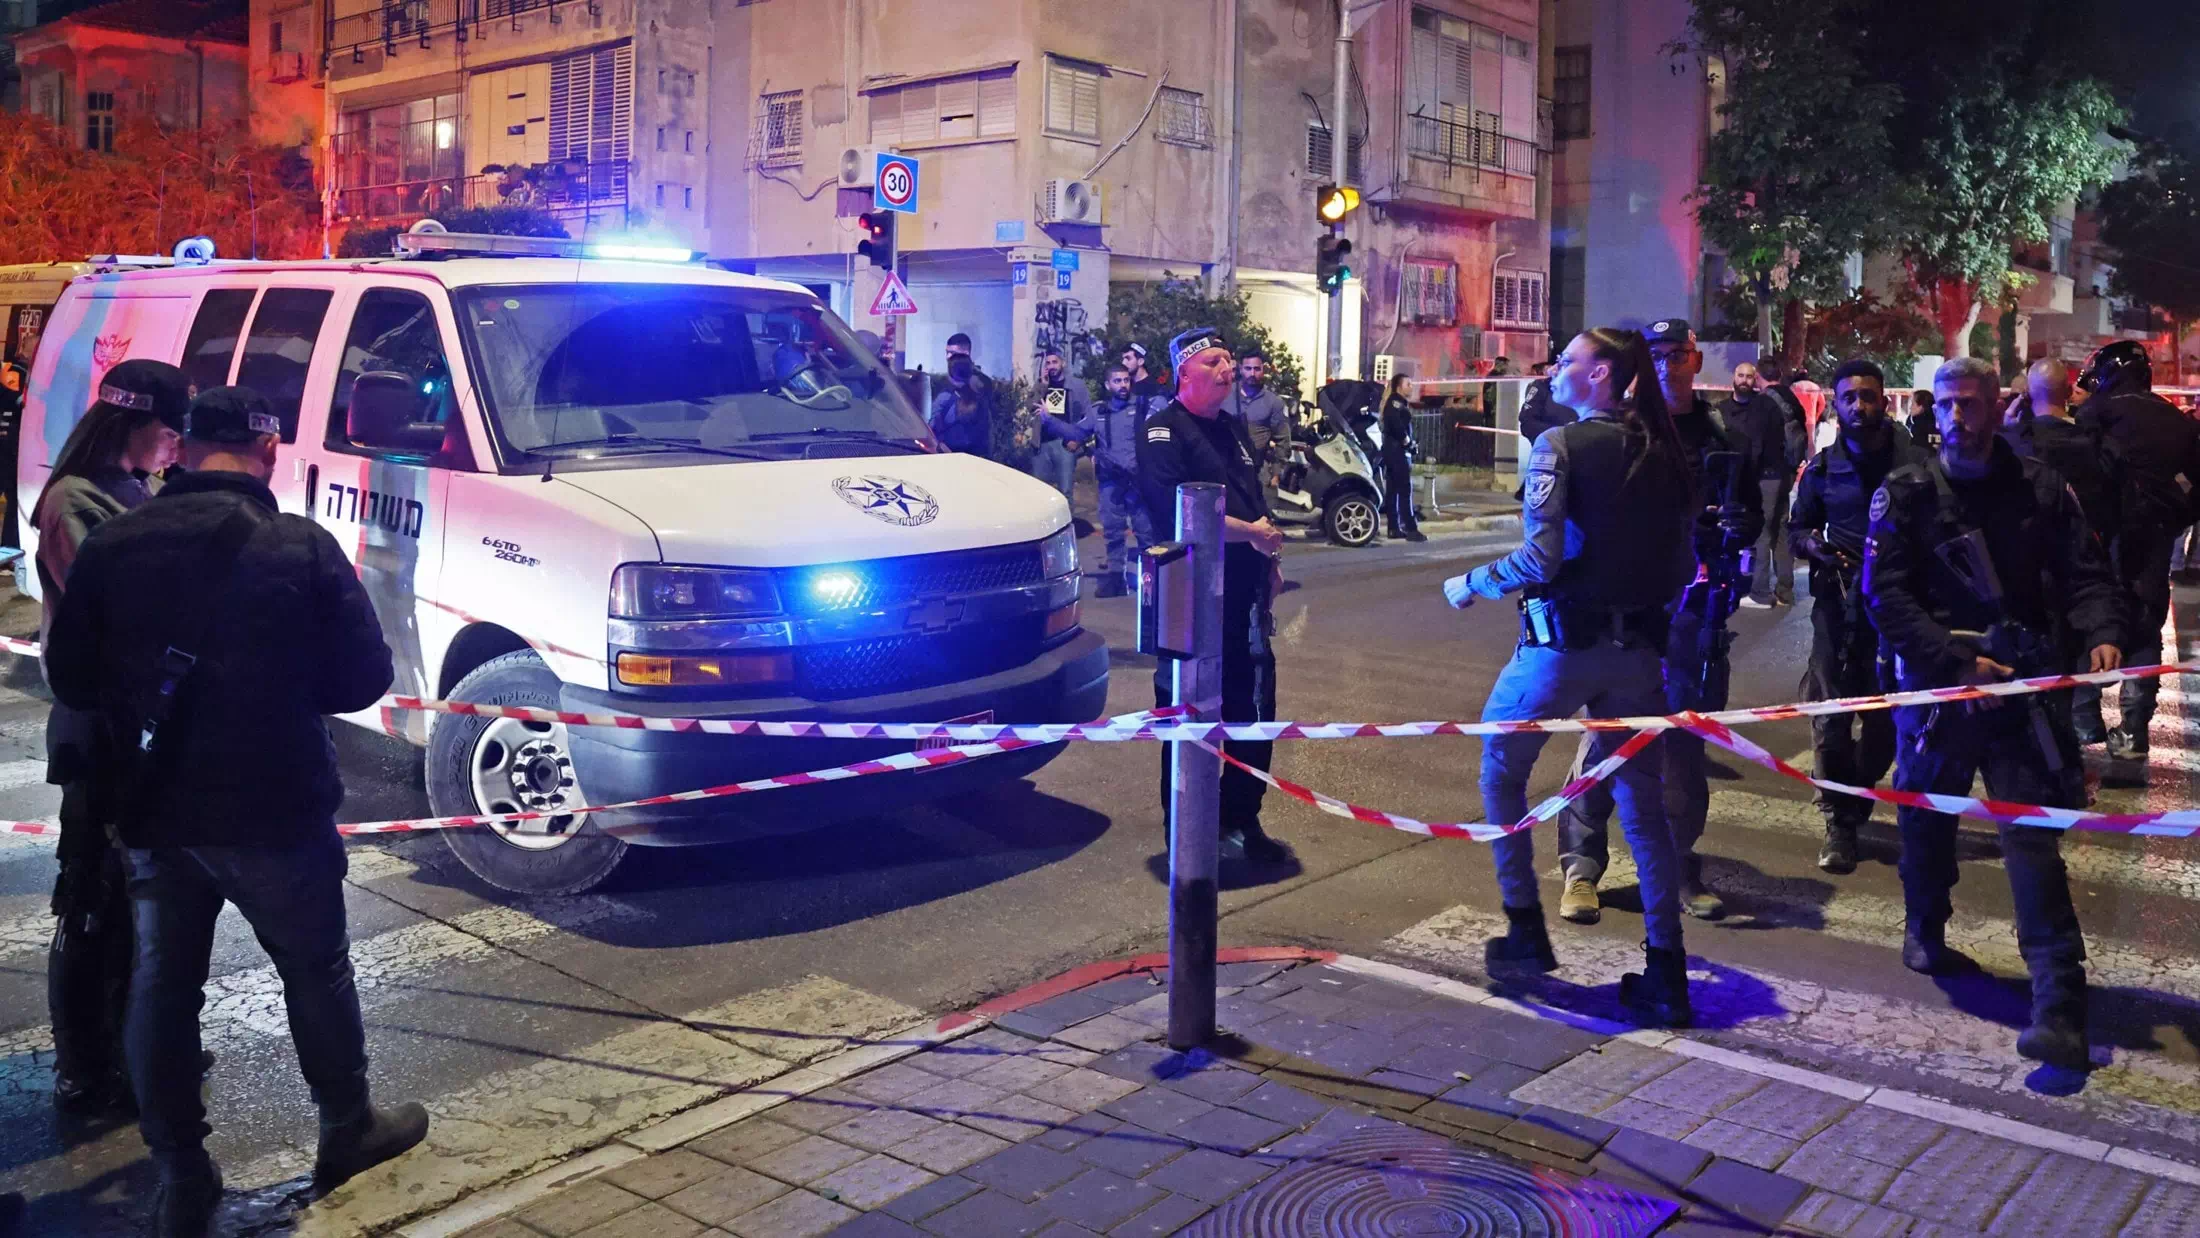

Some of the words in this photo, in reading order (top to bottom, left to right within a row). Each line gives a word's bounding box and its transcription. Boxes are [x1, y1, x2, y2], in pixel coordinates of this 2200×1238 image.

[888, 173, 907, 193] 30
[1015, 269, 1026, 282] 19
[1059, 274, 1070, 286] 19
[327, 483, 424, 539] משטרה
